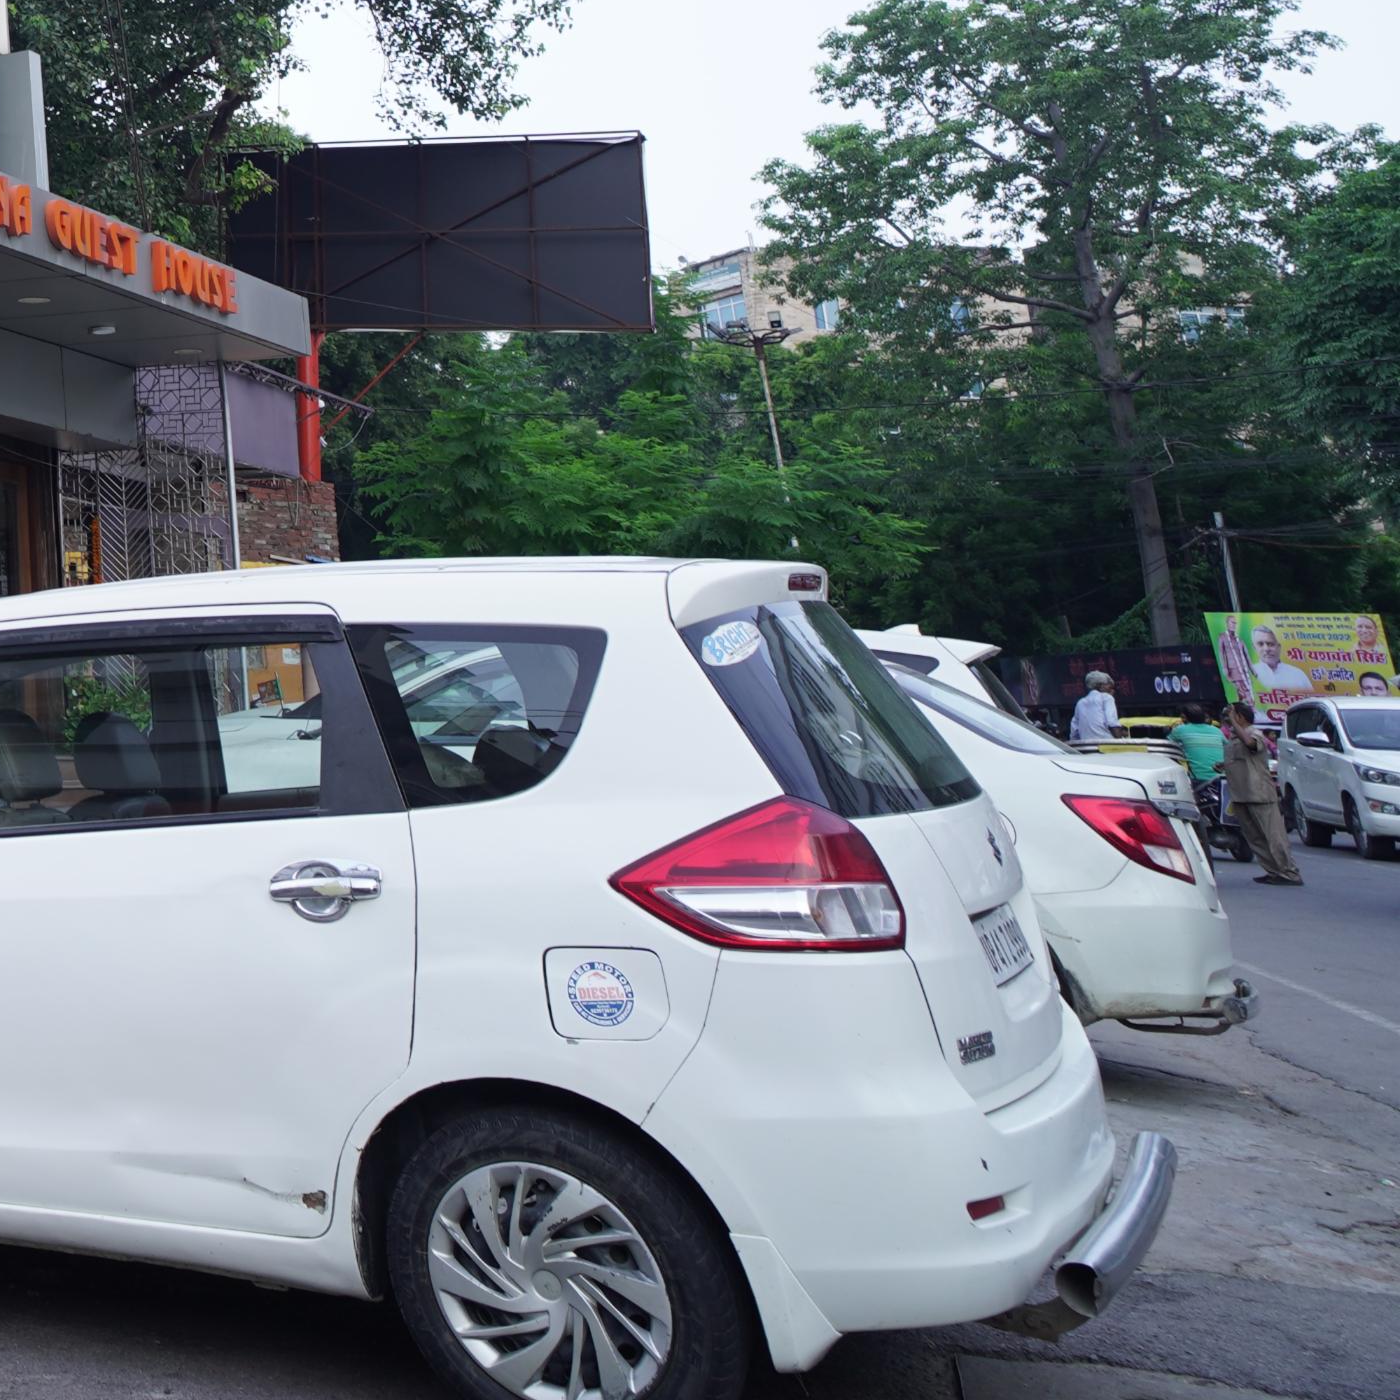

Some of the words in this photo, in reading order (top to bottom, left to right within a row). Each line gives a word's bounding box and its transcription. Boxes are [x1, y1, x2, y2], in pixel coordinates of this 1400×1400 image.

[45, 200, 139, 275] GUEST
[151, 241, 238, 314] HOUSE
[703, 622, 752, 663] BRIGHT
[1287, 648, 1304, 661] श्री
[568, 963, 591, 995] SPEED
[577, 986, 625, 1000] DIESEL
